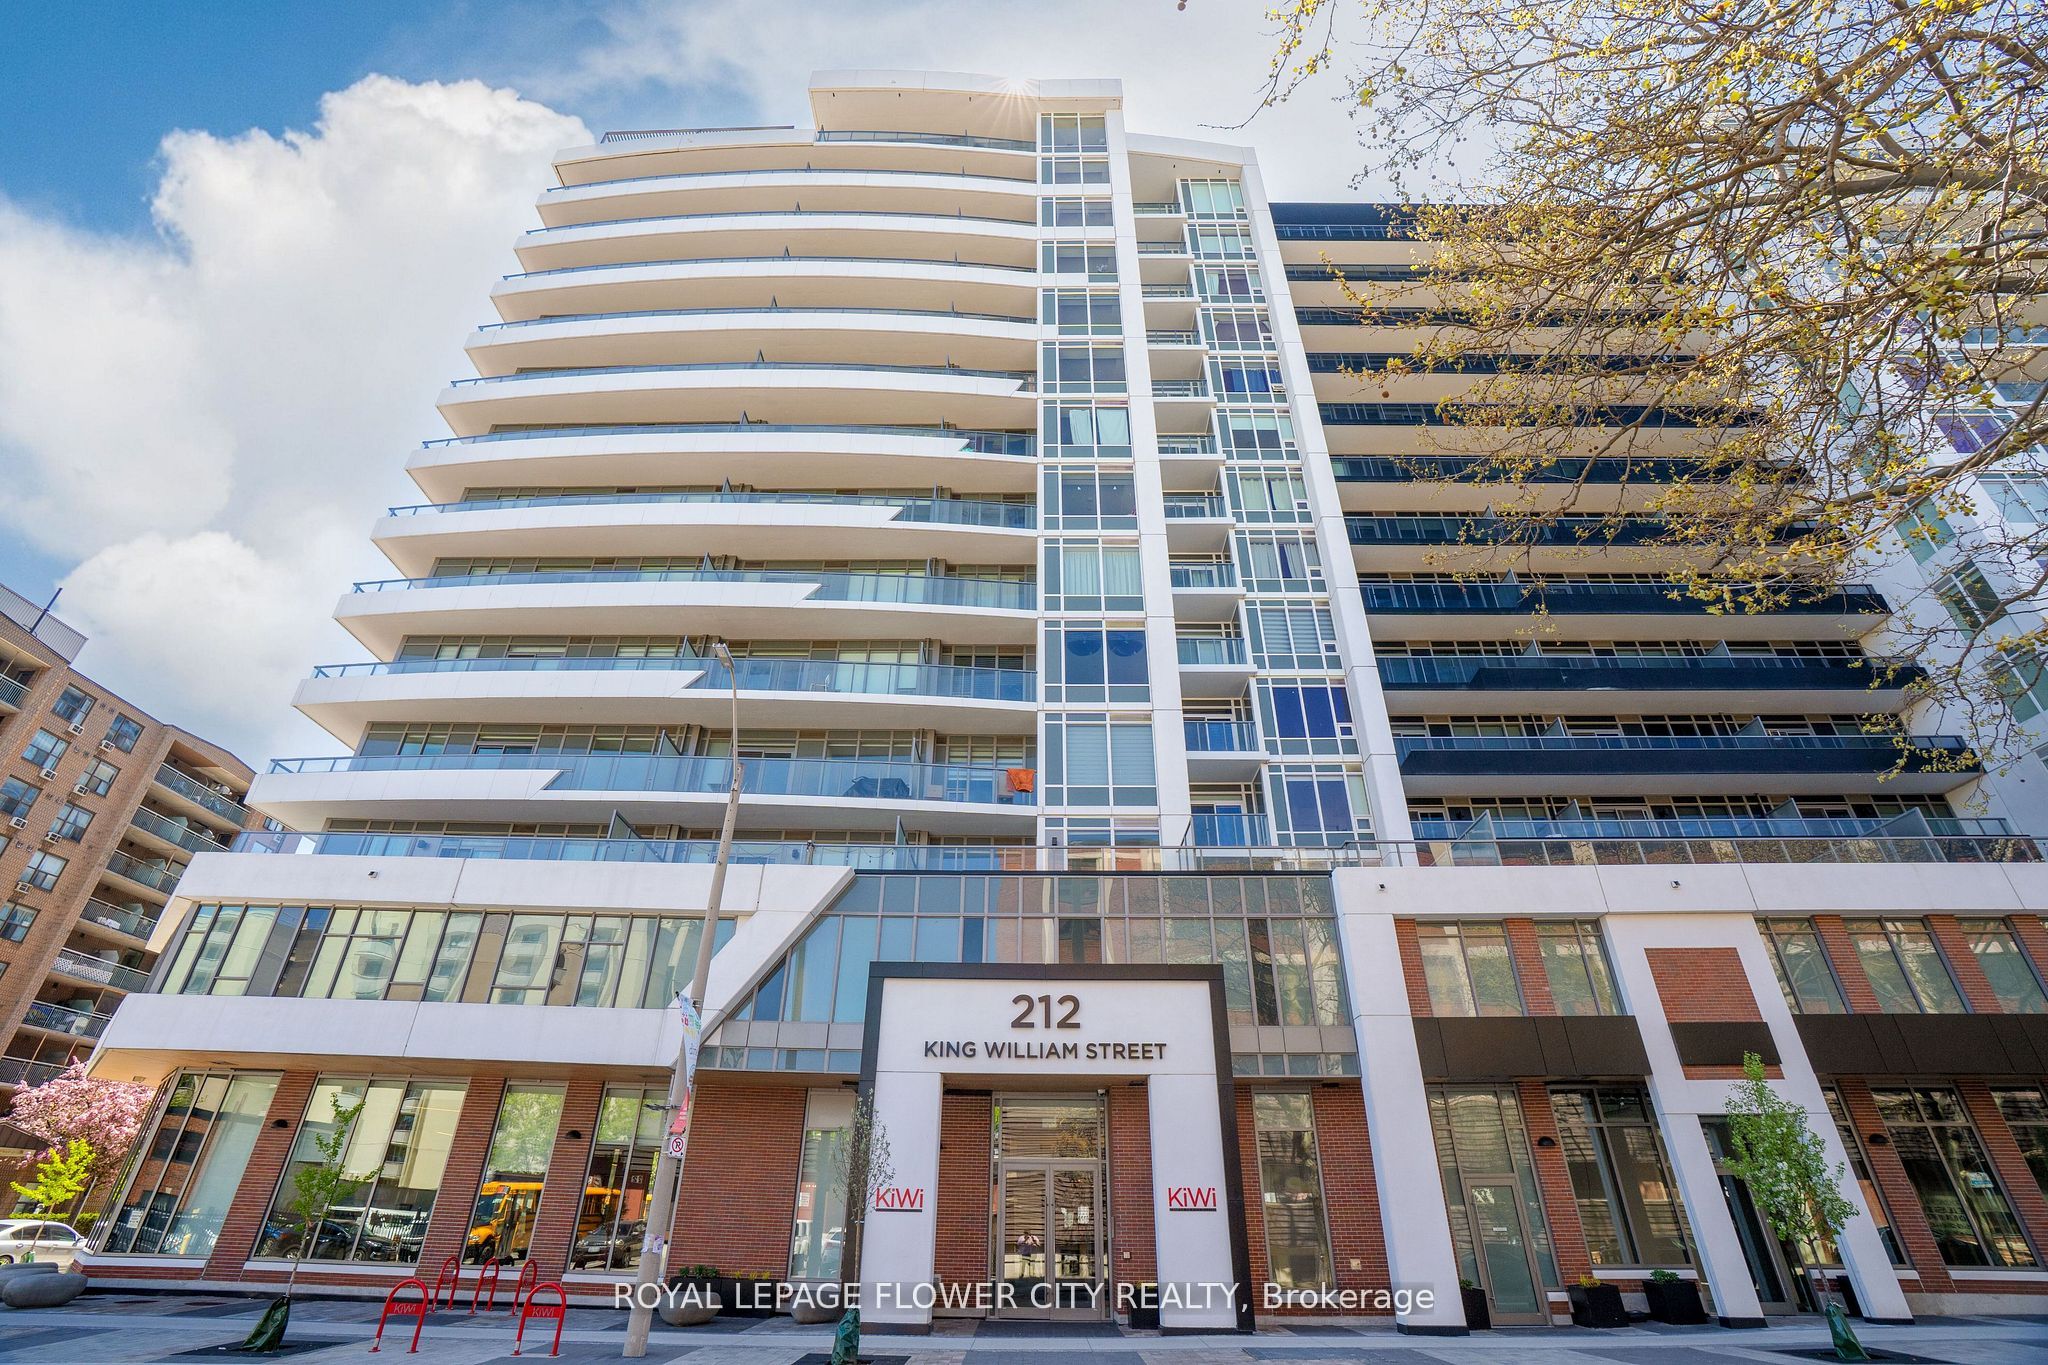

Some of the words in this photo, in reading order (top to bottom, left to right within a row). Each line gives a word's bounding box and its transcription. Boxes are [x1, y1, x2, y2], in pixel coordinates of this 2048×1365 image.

[1011, 994, 1081, 1029] 212
[925, 1040, 977, 1058] KING
[984, 1041, 1078, 1060] WILLIAM
[1086, 1043, 1167, 1060] STREET
[875, 1187, 924, 1208] KiWi
[1168, 1187, 1217, 1208] KiWi
